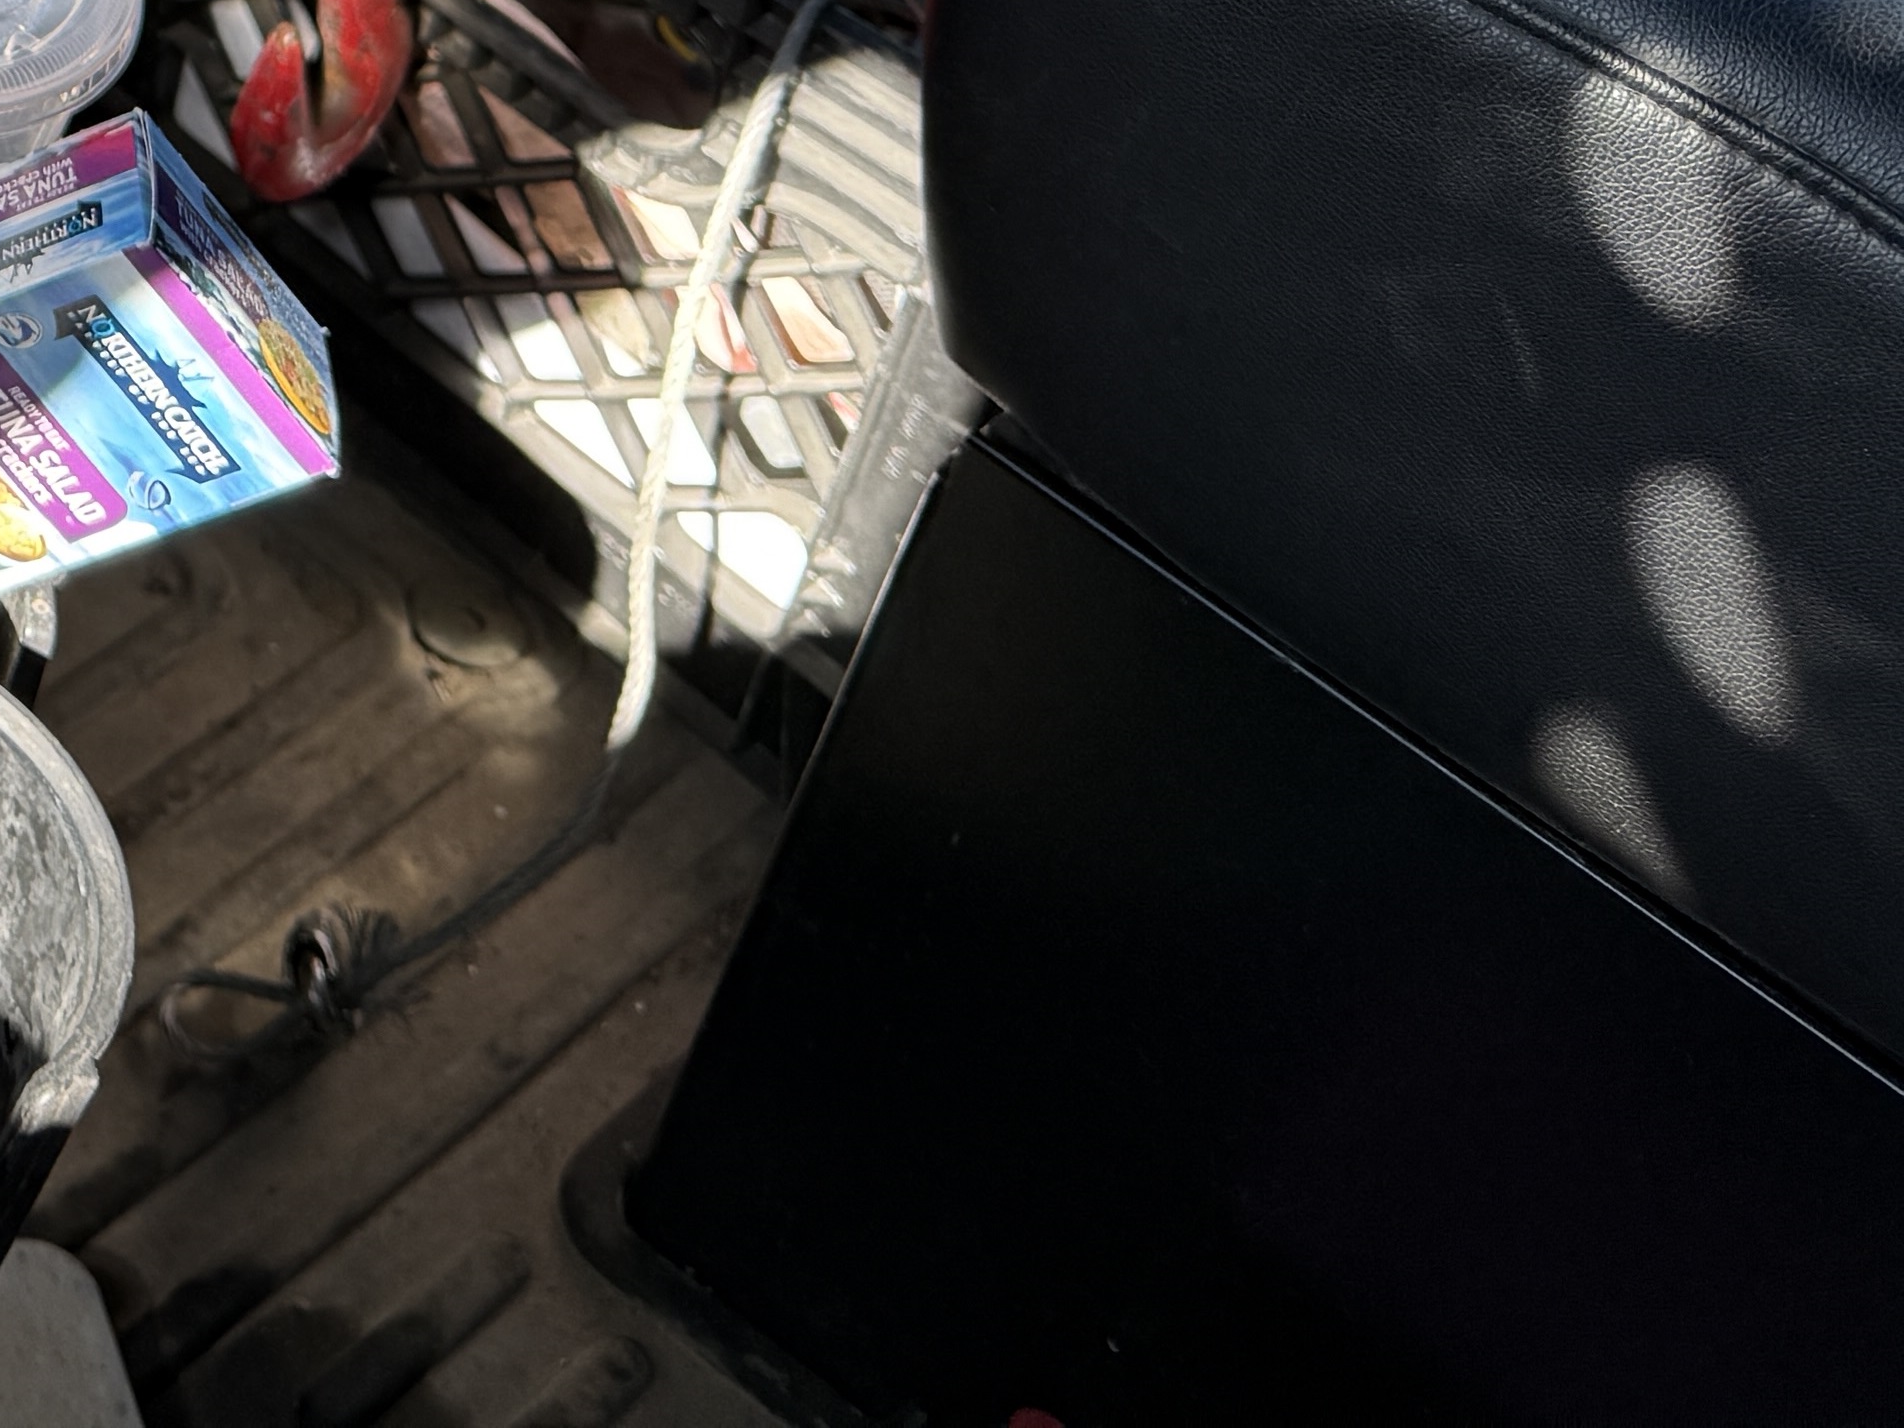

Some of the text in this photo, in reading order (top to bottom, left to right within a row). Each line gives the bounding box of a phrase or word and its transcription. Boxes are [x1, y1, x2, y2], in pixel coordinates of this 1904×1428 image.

[22, 163, 76, 200] TUNA
[42, 155, 72, 177] with
[0, 211, 95, 261] NORTHERN
[7, 385, 42, 419] READY
[73, 299, 180, 414] NORTHERN
[160, 401, 231, 475] CATCH
[26, 447, 109, 527] SALAD
